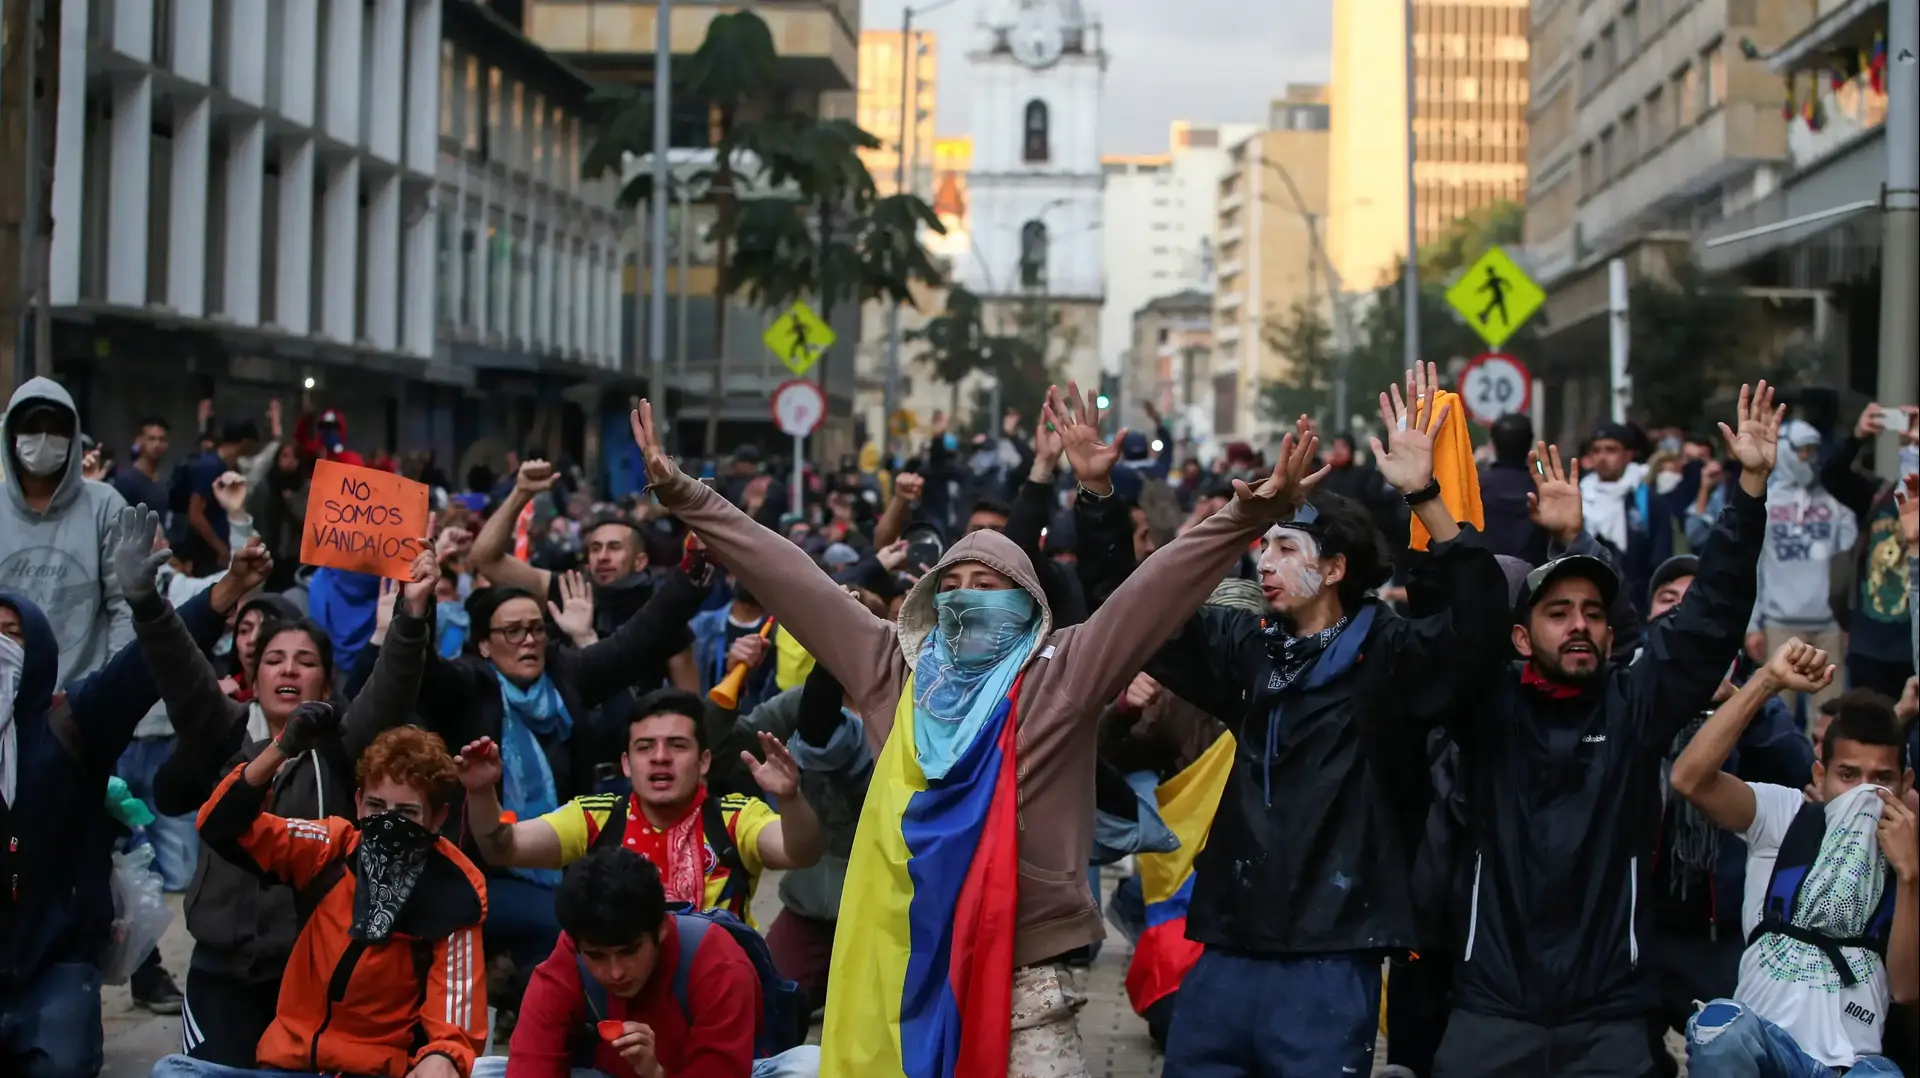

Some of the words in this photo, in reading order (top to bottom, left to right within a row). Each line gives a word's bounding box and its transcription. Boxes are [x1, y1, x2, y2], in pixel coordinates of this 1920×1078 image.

[1477, 375, 1514, 403] 20
[341, 477, 371, 501] NO
[325, 500, 403, 525] SOMOS
[1844, 1000, 1876, 1026] ROCA
